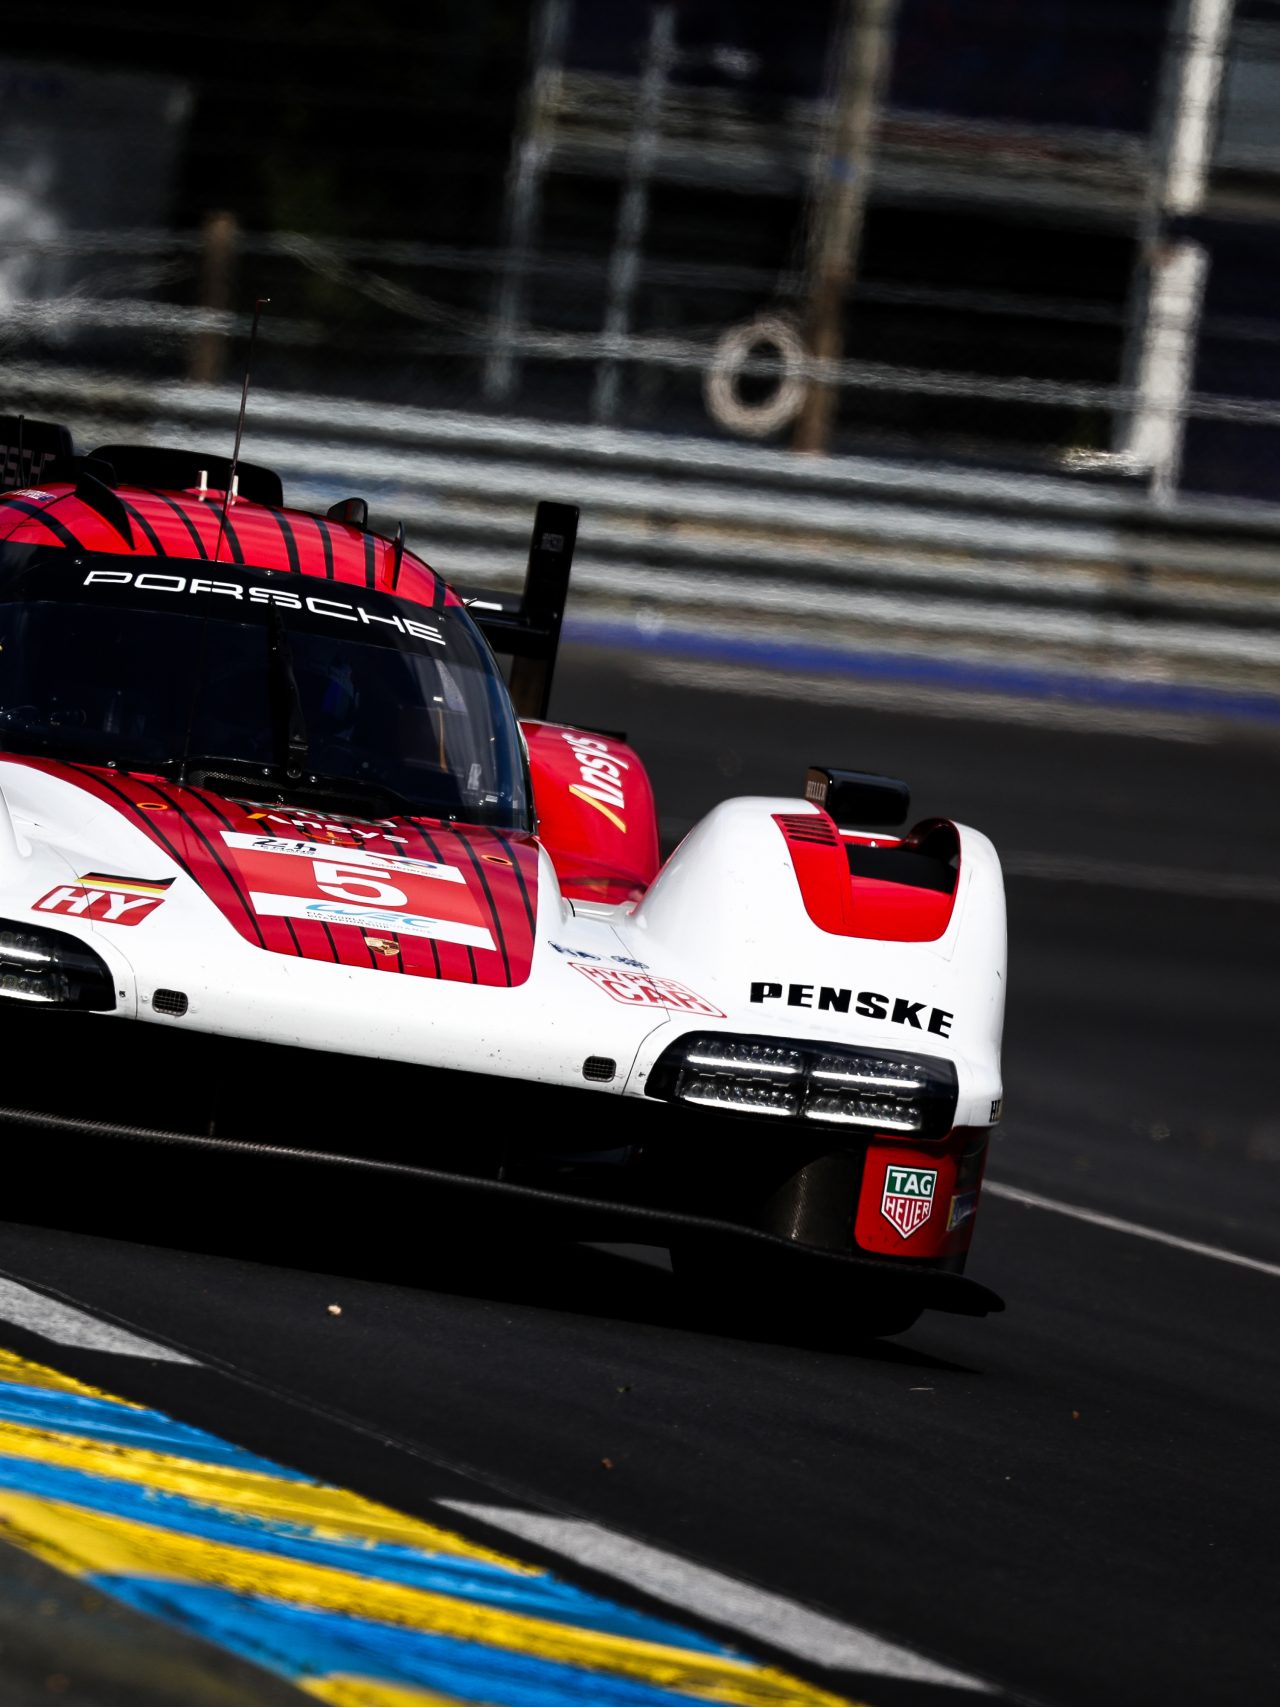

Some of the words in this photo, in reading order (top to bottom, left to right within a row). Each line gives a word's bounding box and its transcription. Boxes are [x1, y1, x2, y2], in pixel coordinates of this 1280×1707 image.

[83, 570, 446, 646] PORSCHE
[561, 731, 628, 834] Ansys
[246, 812, 409, 844] Ansys
[312, 860, 409, 907] 5
[38, 886, 158, 921] HY
[305, 903, 439, 929] WEC
[579, 965, 688, 992] HYPER
[601, 979, 713, 1013] CAR
[749, 981, 955, 1040] PENSKE
[891, 1171, 933, 1196] TAG
[885, 1196, 931, 1232] HEUER
